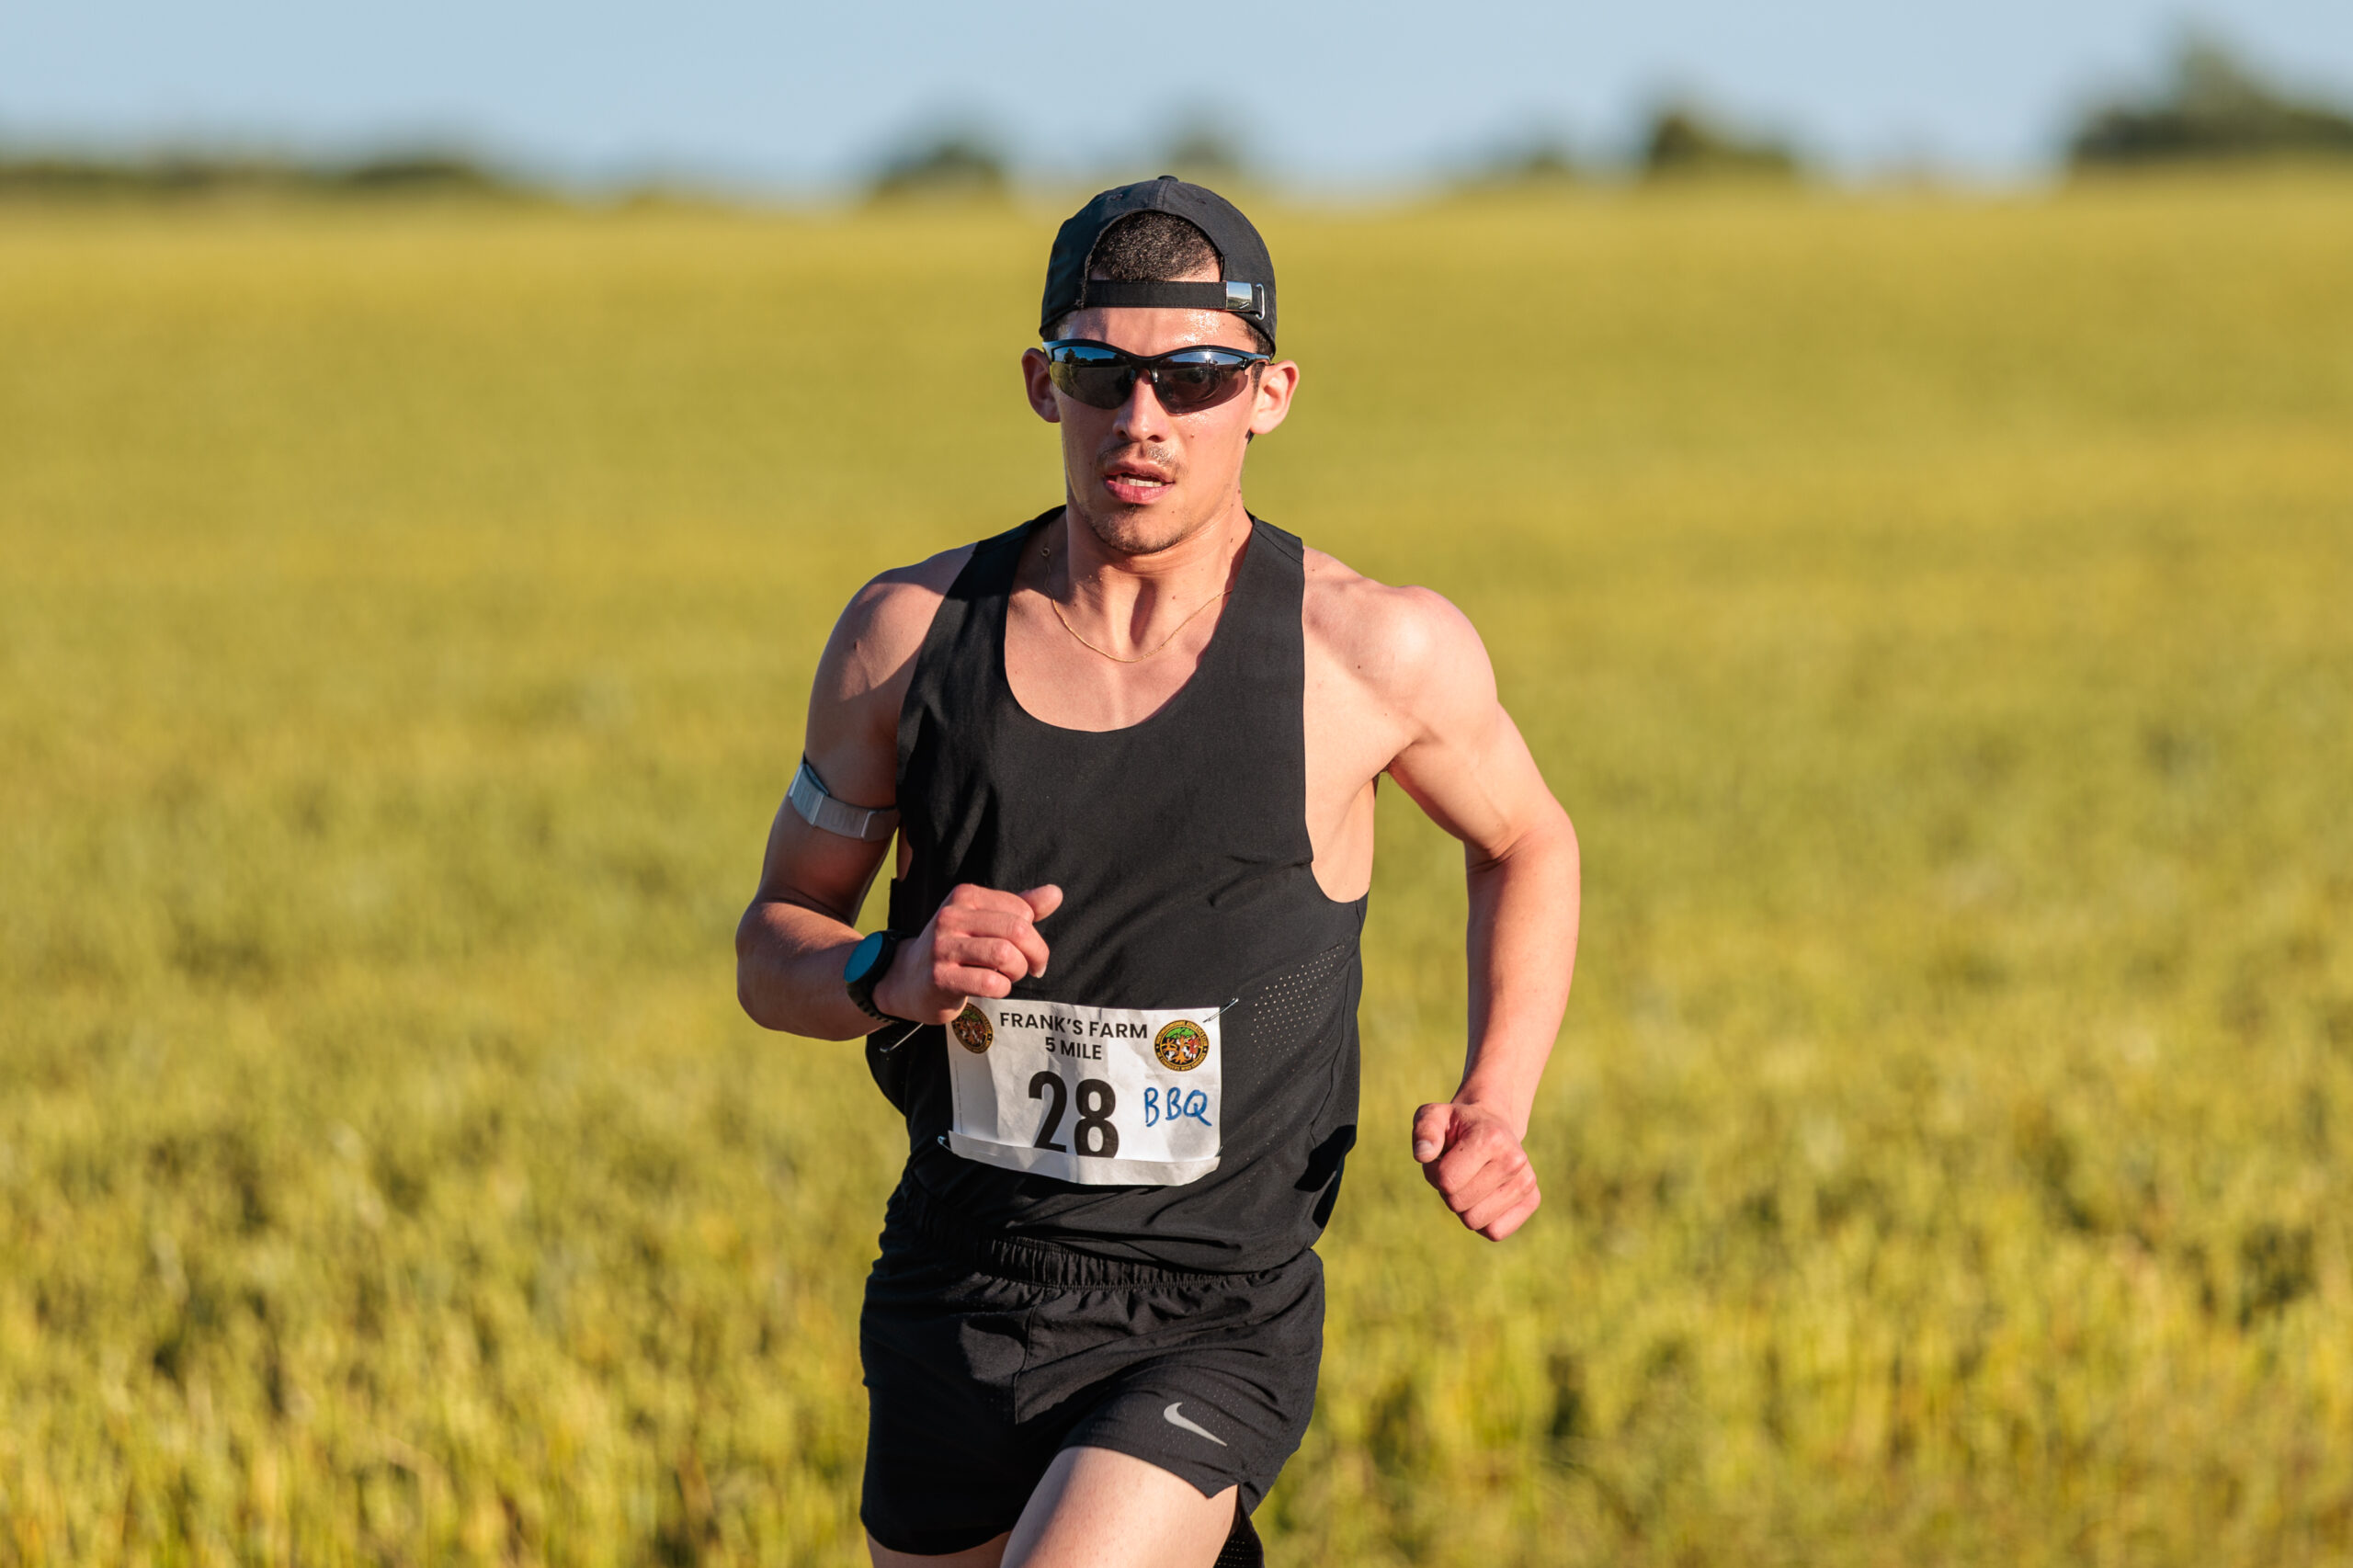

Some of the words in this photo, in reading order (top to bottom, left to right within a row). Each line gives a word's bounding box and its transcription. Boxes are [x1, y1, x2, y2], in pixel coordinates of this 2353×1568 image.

[1000, 1012, 1083, 1035] FRANK'S
[1089, 1021, 1148, 1039] FARM
[1045, 1037, 1056, 1052] 5
[1060, 1040, 1102, 1060] MILE
[1029, 1071, 1120, 1158] 28
[1143, 1086, 1212, 1127] BBQ
